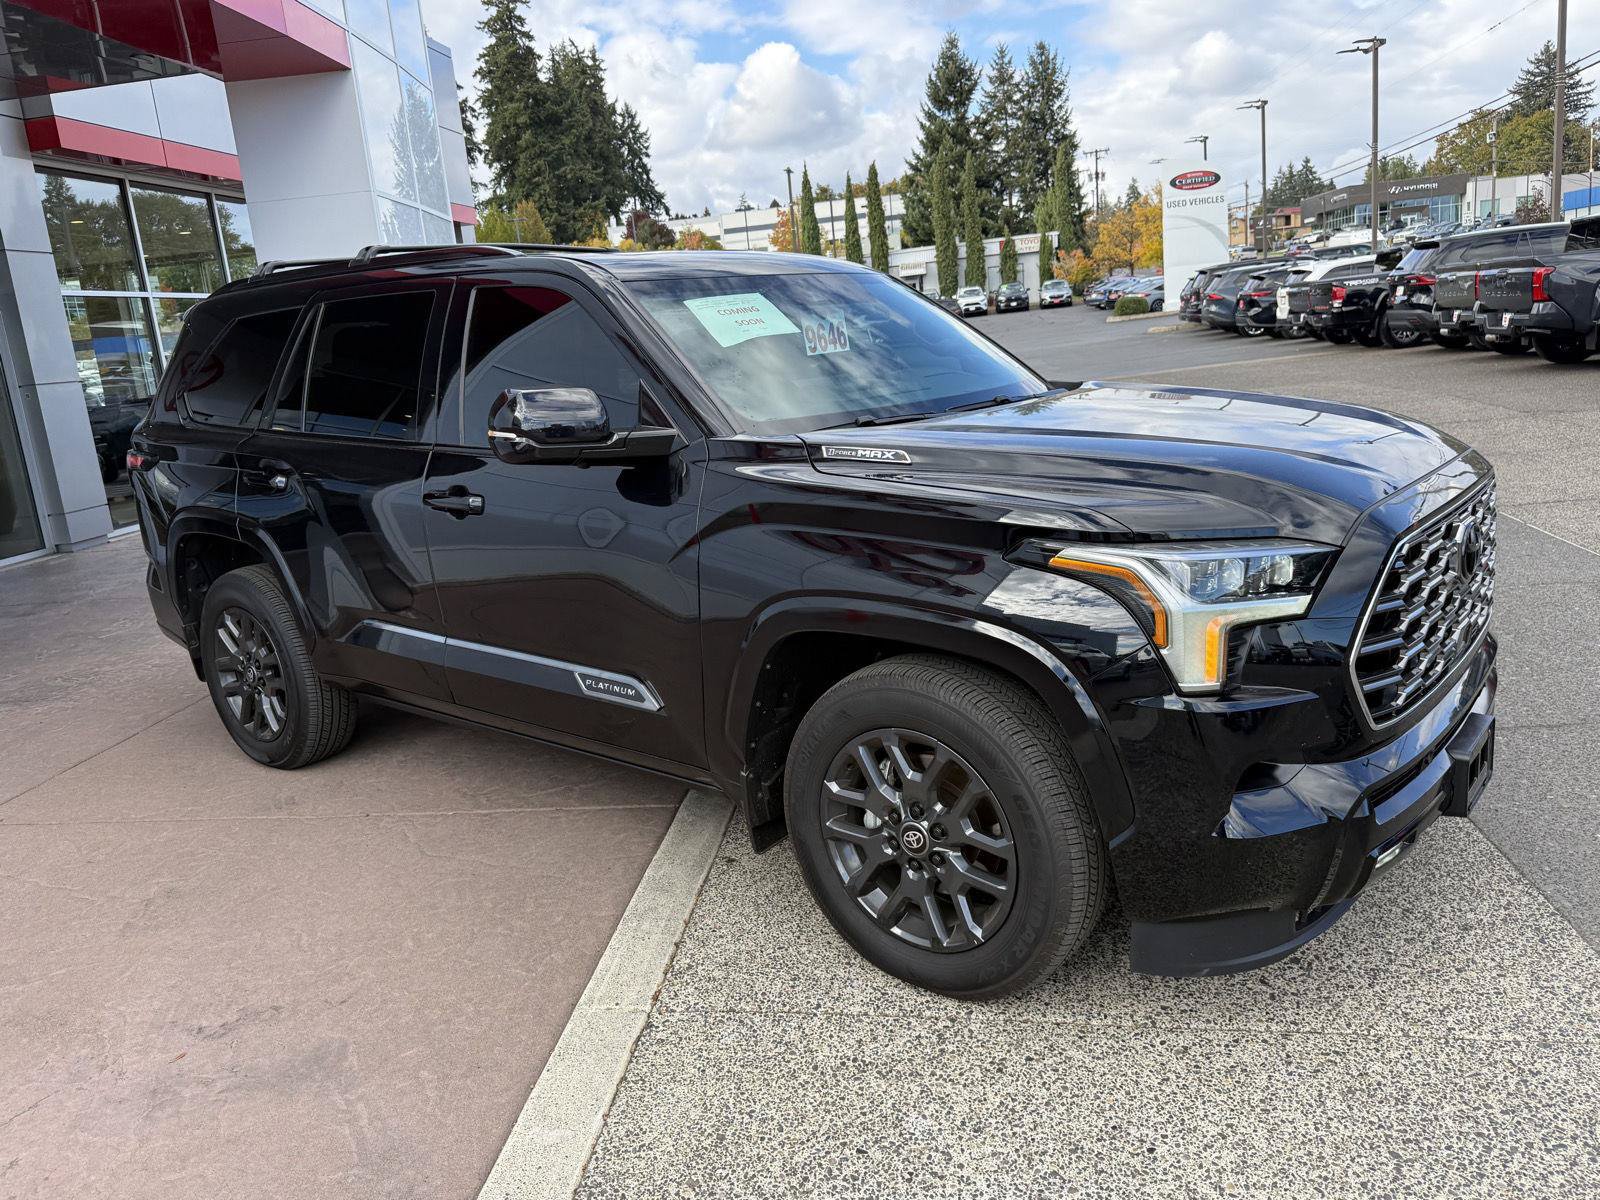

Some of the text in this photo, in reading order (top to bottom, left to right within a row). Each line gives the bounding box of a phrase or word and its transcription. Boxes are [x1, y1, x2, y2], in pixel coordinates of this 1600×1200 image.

[1175, 176, 1215, 186] CERTIFIED
[1166, 195, 1225, 209] USED VEHICLES
[717, 305, 760, 316] COMING
[735, 317, 765, 327] SOON
[804, 320, 848, 353] 9646
[857, 449, 895, 460] MAX
[586, 679, 636, 696] PLATINUM
